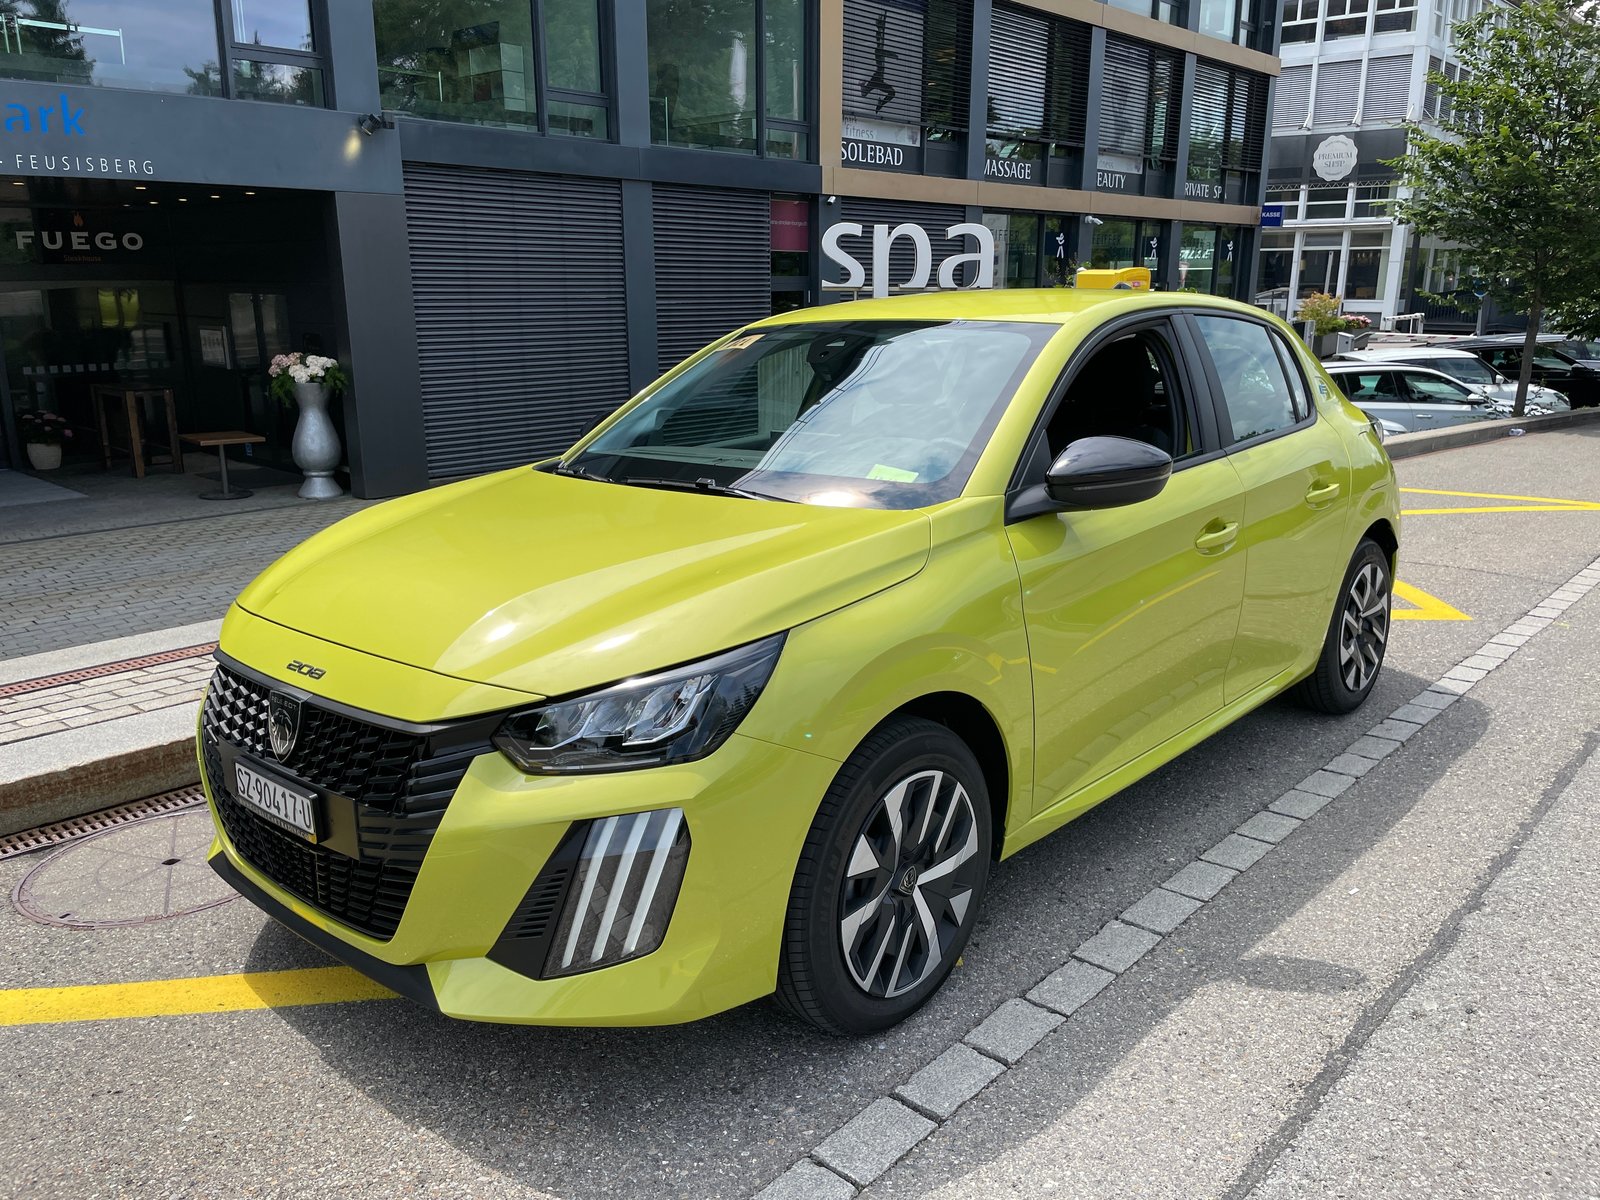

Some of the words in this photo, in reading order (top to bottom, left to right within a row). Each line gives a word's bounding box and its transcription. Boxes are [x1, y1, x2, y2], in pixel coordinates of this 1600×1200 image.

[845, 124, 875, 140] fitness
[841, 141, 904, 167] SOLEBAD
[1318, 152, 1353, 160] PREMIUM
[15, 154, 154, 175] FEUSISBERG
[15, 230, 143, 250] FUEGO
[821, 222, 995, 298] spa
[287, 660, 326, 680] 208
